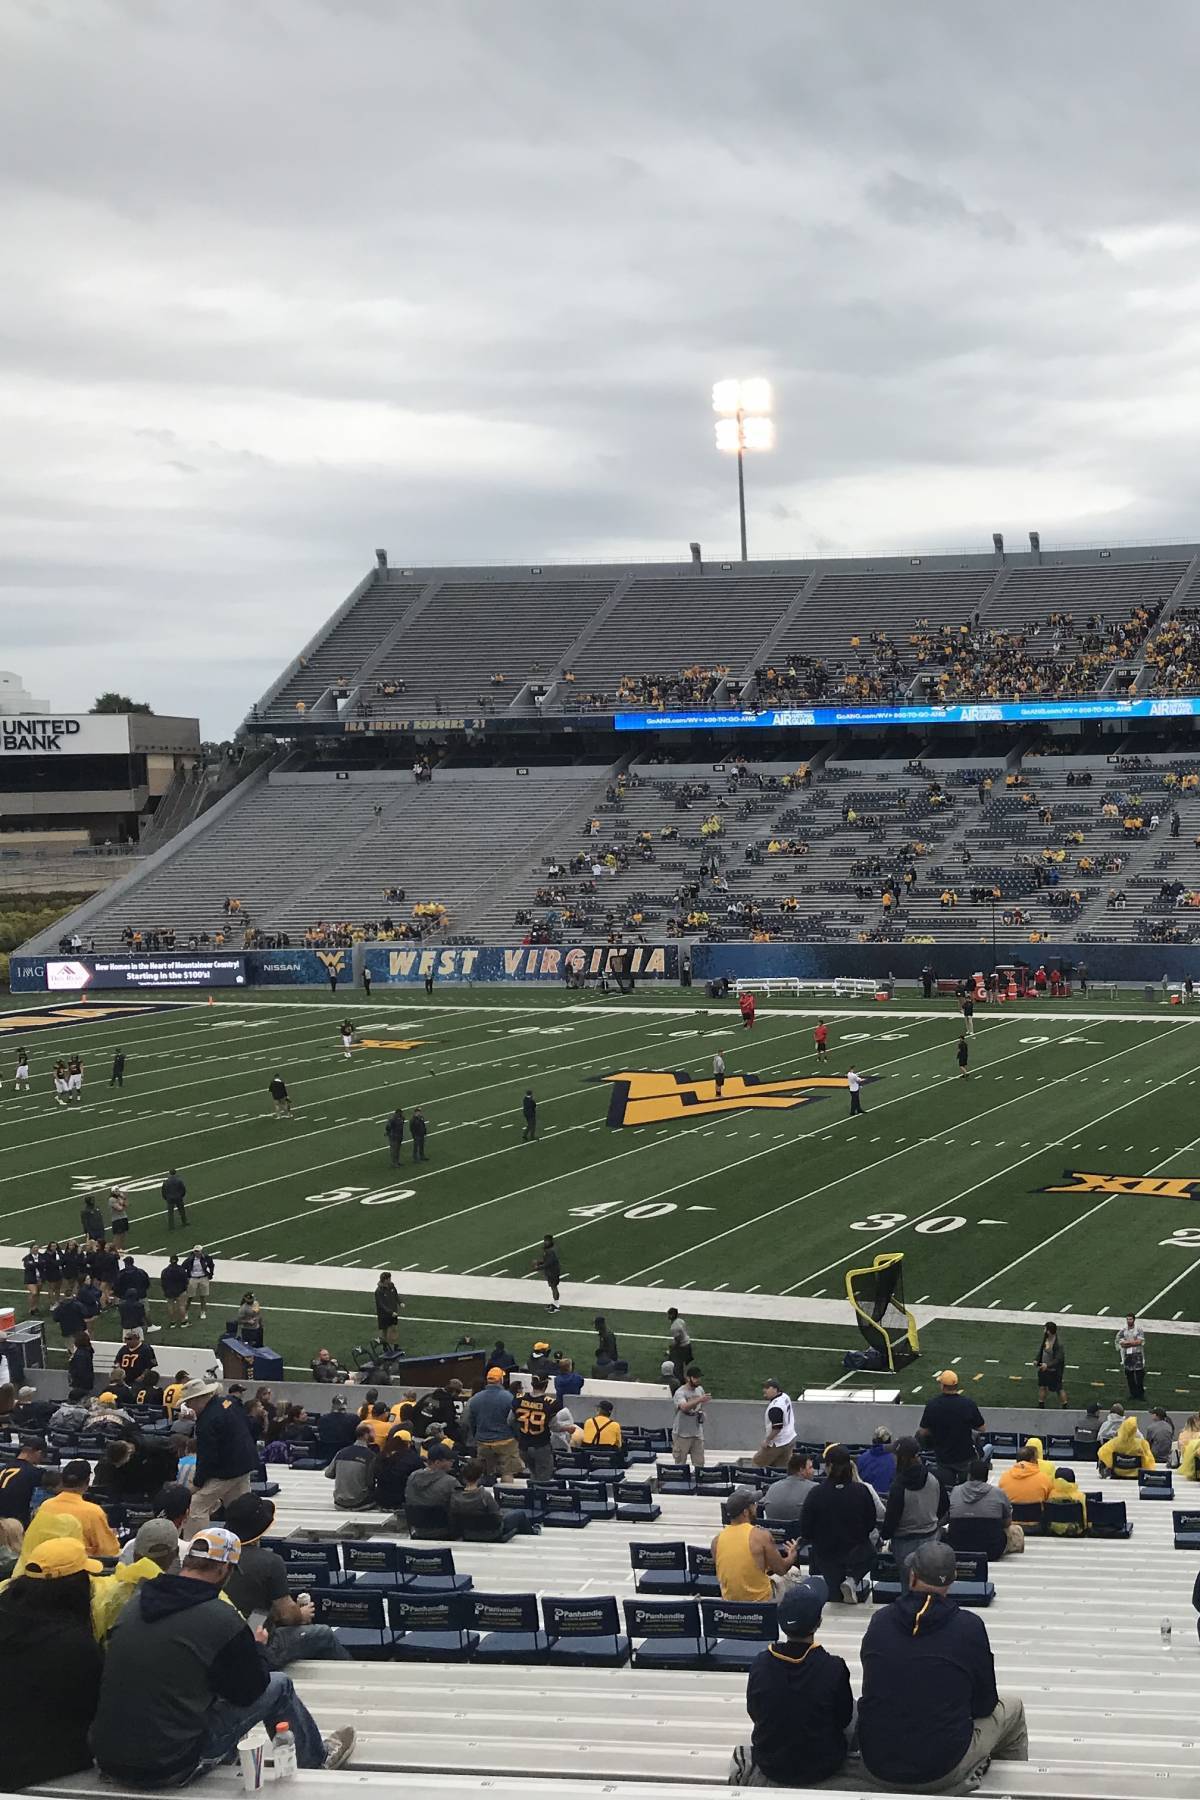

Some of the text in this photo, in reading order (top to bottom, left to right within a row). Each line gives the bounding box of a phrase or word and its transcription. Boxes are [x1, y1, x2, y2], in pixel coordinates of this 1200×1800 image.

[960, 709, 978, 722] AIR
[1150, 703, 1170, 716] AIR
[345, 722, 364, 732] IRA
[472, 720, 486, 728] 21
[772, 713, 791, 726] AIR
[3, 720, 80, 734] UNITED
[4, 736, 61, 750] BANK
[138, 962, 148, 970] the
[150, 962, 167, 970] Heart
[176, 961, 212, 970] Mountaineer
[389, 950, 478, 976] WEST
[17, 967, 44, 977] IMG
[126, 972, 158, 980] Starting
[168, 972, 182, 980] the
[840, 1033, 910, 1041] 50
[305, 1187, 416, 1206] 50
[568, 1201, 678, 1219] 40
[850, 1212, 967, 1234] 30
[122, 1354, 138, 1368] 67
[136, 1390, 146, 1404] 8
[166, 1389, 174, 1404] 8
[517, 1410, 546, 1436] 39
[564, 1610, 603, 1618] Panhandle
[646, 1612, 685, 1620] Panhandle
[724, 1614, 763, 1622] Panhandle
